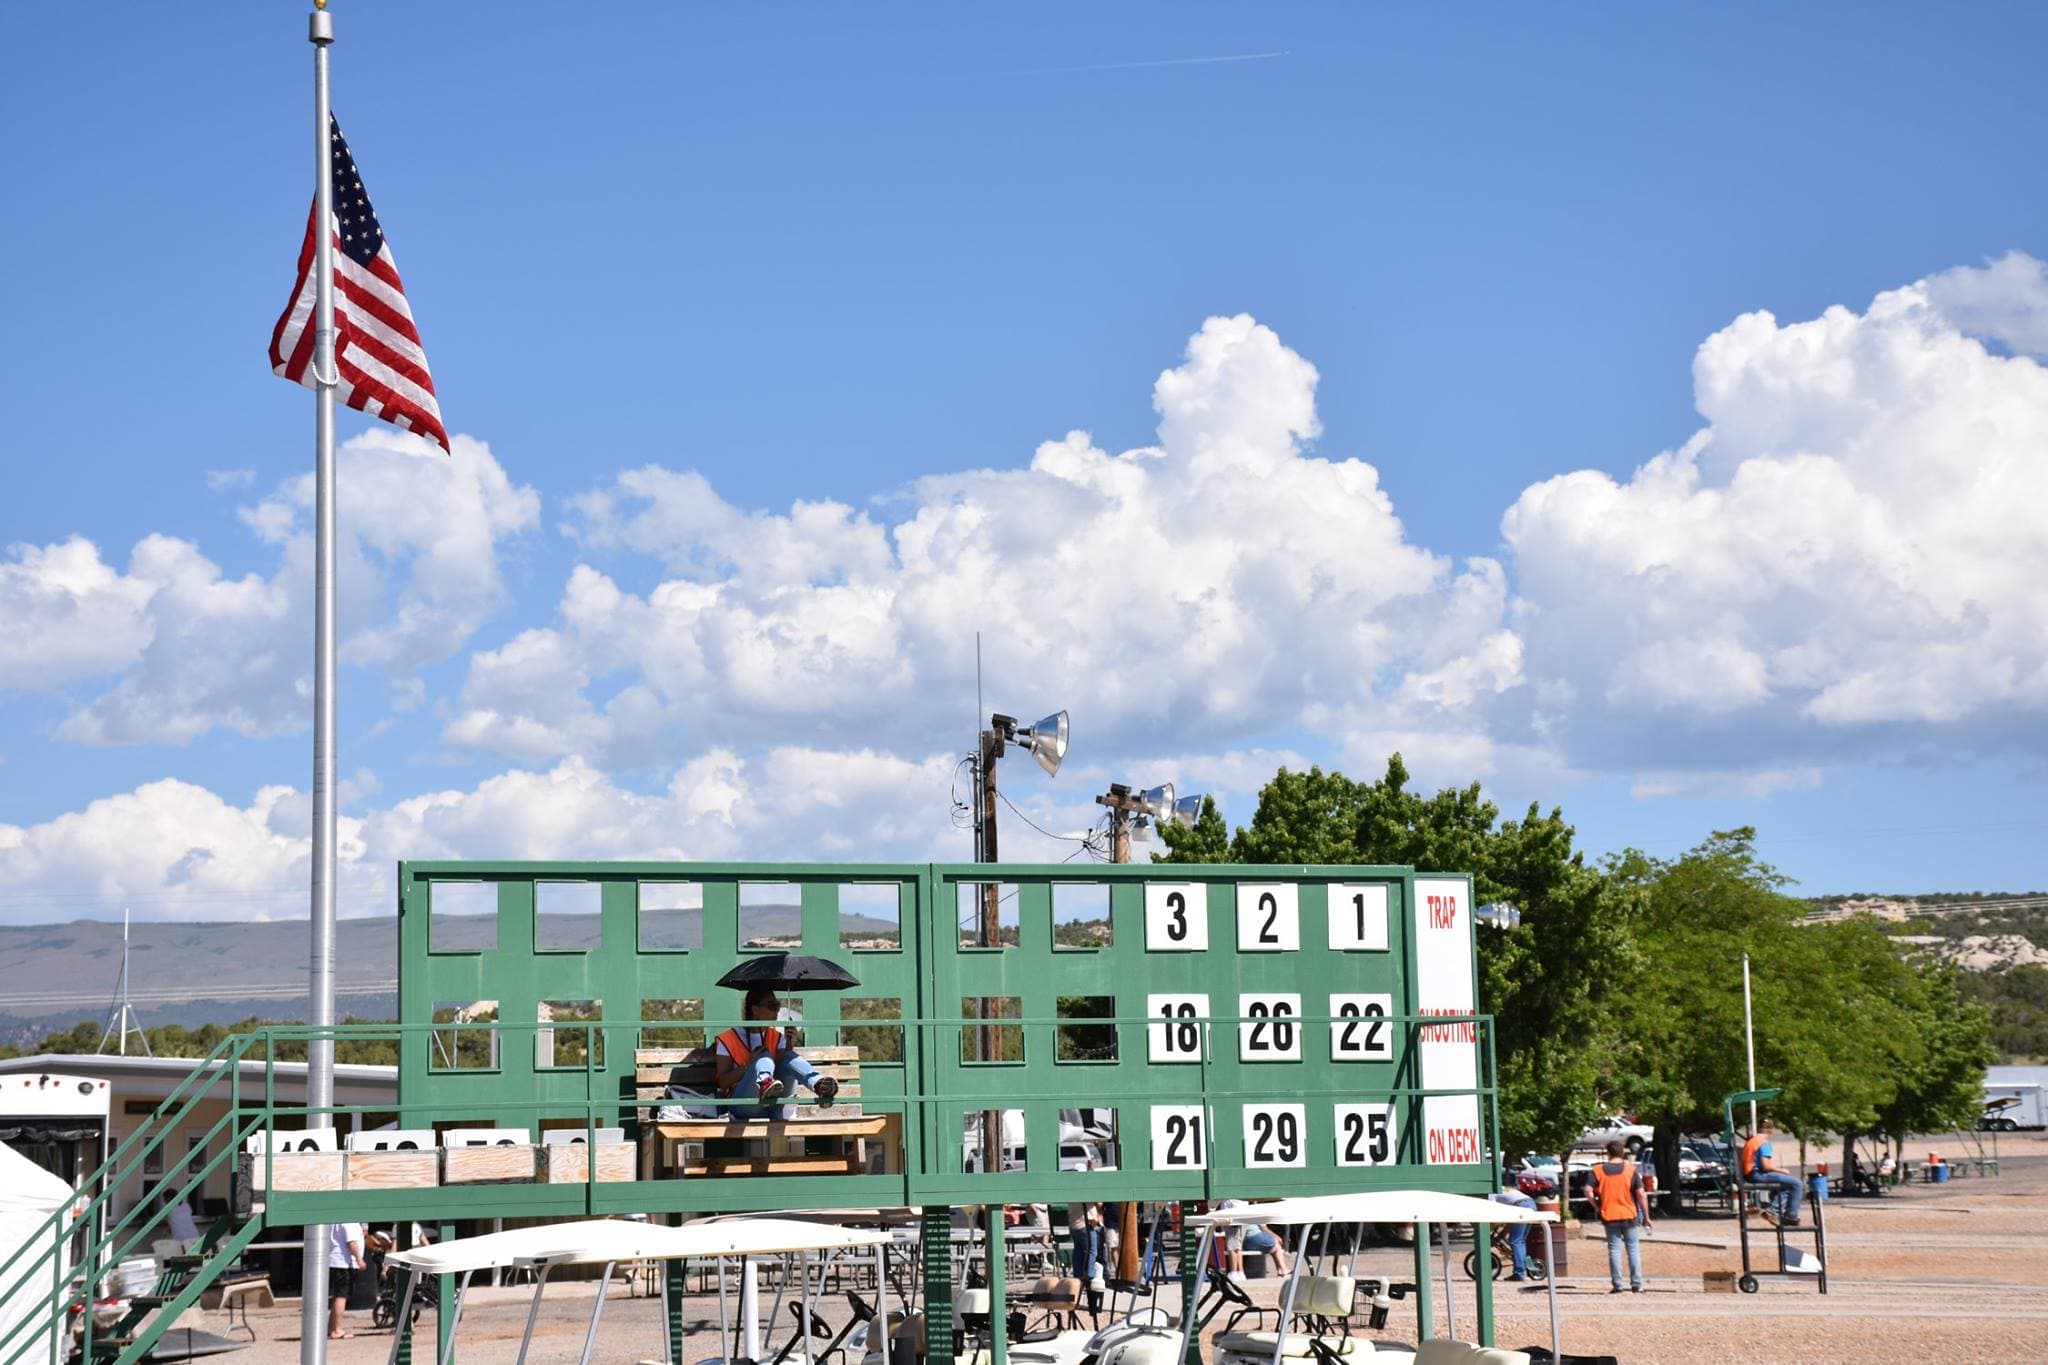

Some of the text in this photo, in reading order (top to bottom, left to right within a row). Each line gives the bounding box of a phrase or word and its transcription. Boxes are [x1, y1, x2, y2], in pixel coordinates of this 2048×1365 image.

[1166, 892, 1187, 941] 3
[1258, 892, 1279, 944] 2
[1353, 893, 1365, 940] 1
[1426, 895, 1456, 929] TRAP
[1161, 1002, 1198, 1052] 18
[1249, 1001, 1293, 1051] 26
[1340, 1002, 1385, 1051] 22
[1166, 1115, 1201, 1165] 21
[1253, 1112, 1298, 1163] 29
[1344, 1112, 1389, 1163] 25
[1429, 1128, 1479, 1164] ON DECK
